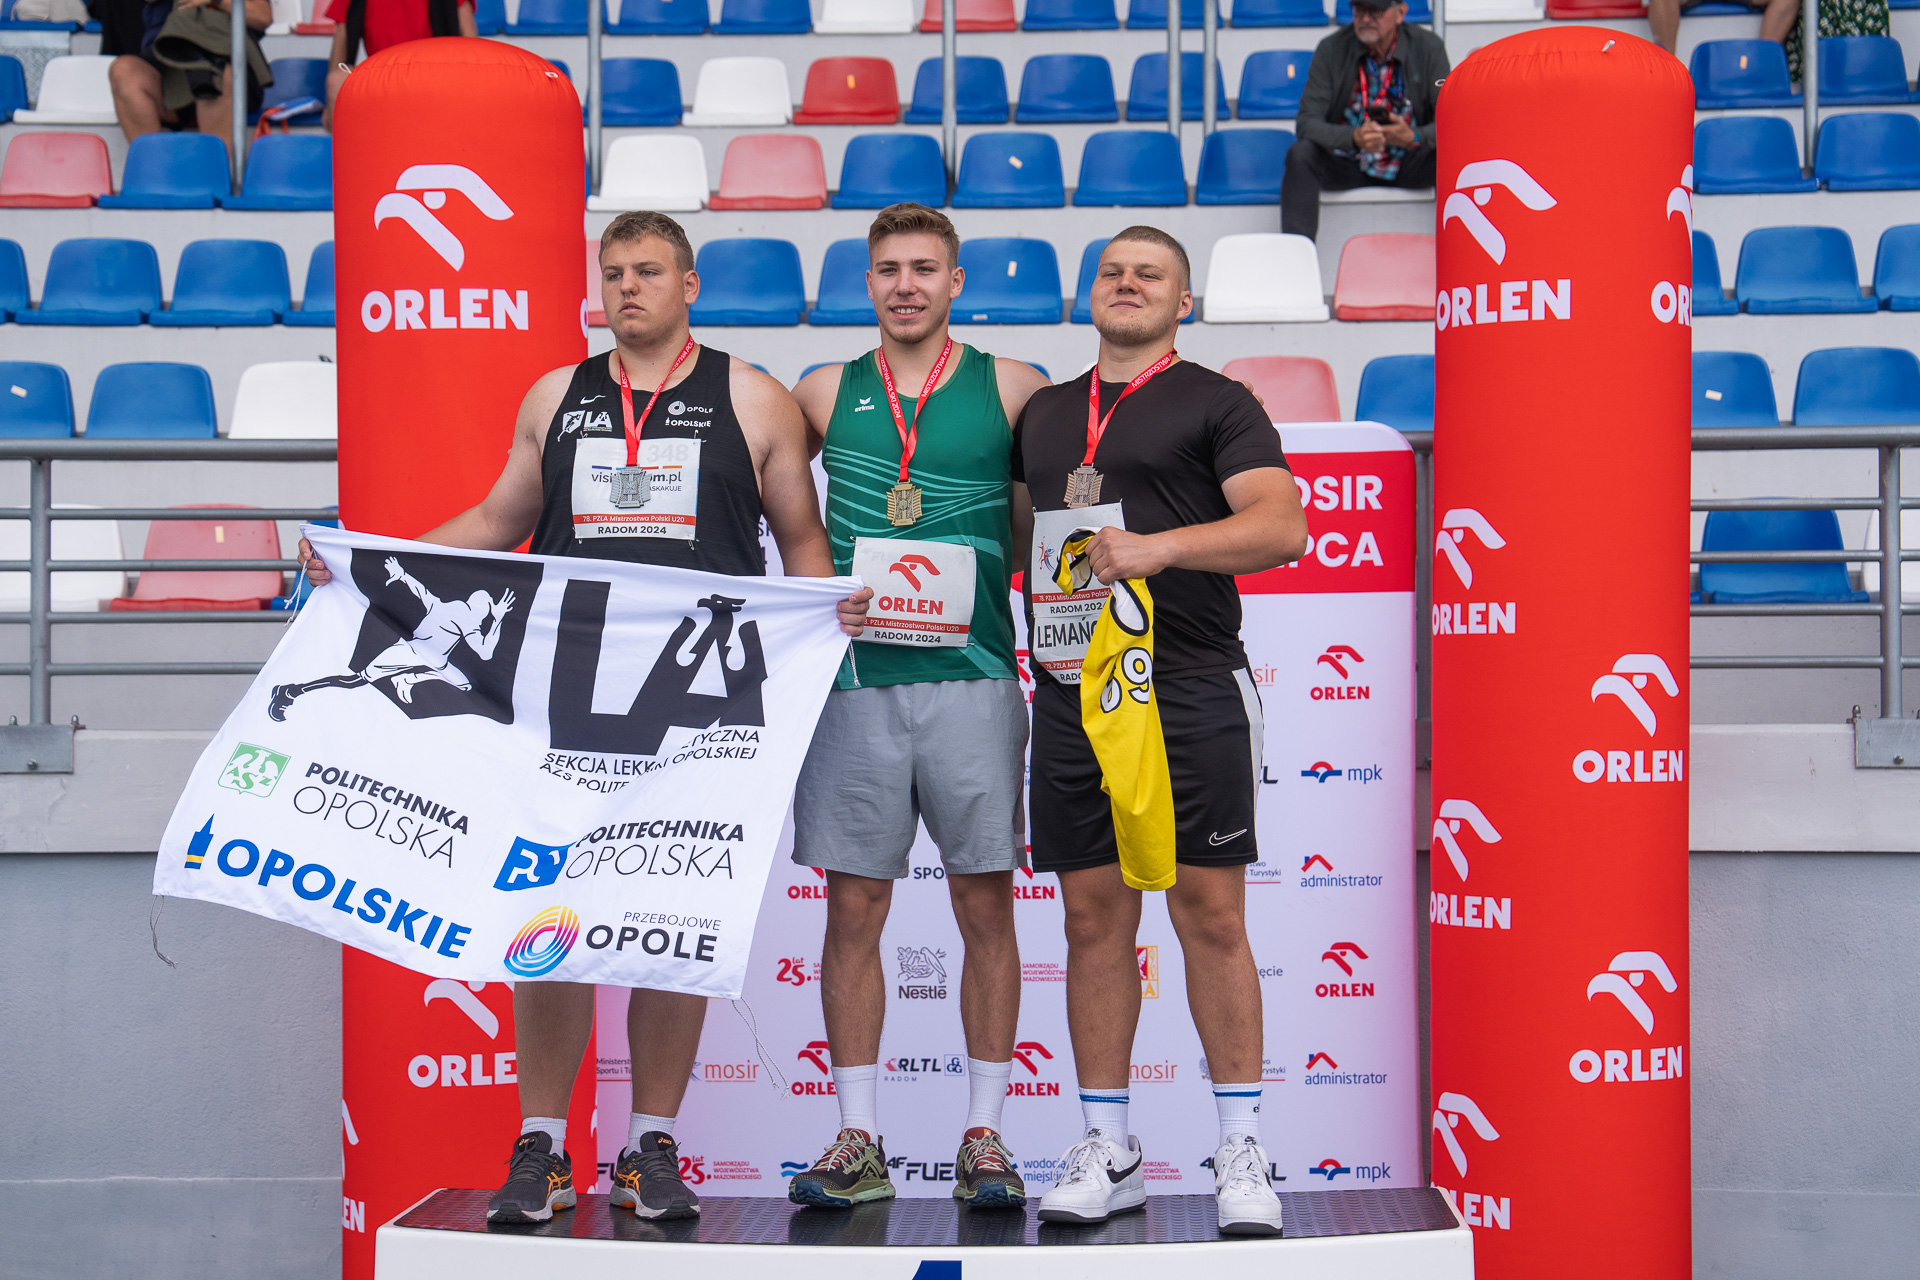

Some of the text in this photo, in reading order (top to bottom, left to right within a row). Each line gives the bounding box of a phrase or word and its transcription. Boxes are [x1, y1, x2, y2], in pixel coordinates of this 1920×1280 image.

[361, 288, 529, 333] ORLEN
[1436, 279, 1571, 331] ORLEN
[854, 404, 875, 412] erima
[671, 419, 711, 427] OPOLSKIE
[598, 526, 667, 534] RADOM 2024
[878, 596, 943, 615] ORLEN
[1050, 602, 1104, 614] RADOM 202
[886, 620, 925, 630] Mistrzostwa
[926, 623, 946, 631] Polski
[1432, 602, 1516, 636] ORLEN
[874, 630, 941, 643] RADOM 2024
[1254, 664, 1277, 683] sir
[1310, 686, 1370, 700] ORLEN
[544, 752, 608, 774] SEKCJA
[672, 746, 757, 764] OPOLSKIEJ
[1348, 764, 1382, 784] mpk
[1572, 750, 1683, 783] ORLEN
[305, 762, 469, 835] POLITECHNIKA
[294, 786, 454, 868] OPOLSKA
[576, 820, 744, 848] POLITECHNIKA
[566, 844, 733, 879] OPOLSKA
[1301, 874, 1382, 887] administrator
[217, 838, 472, 959] OPOLSKIE
[1013, 885, 1055, 899] RLEN
[1430, 891, 1511, 929] ORLEN
[623, 911, 721, 931] PRZEBOJOWE
[586, 925, 718, 962] OPOLE
[1315, 983, 1374, 998] ORLEN
[408, 1052, 518, 1088] ORLE
[704, 1059, 759, 1079] mosir
[1569, 1045, 1683, 1083] ORLEN
[791, 1081, 838, 1096] ORLE
[1305, 1072, 1387, 1085] administrator
[905, 1163, 957, 1181] FUE
[1356, 1162, 1391, 1182] mpk
